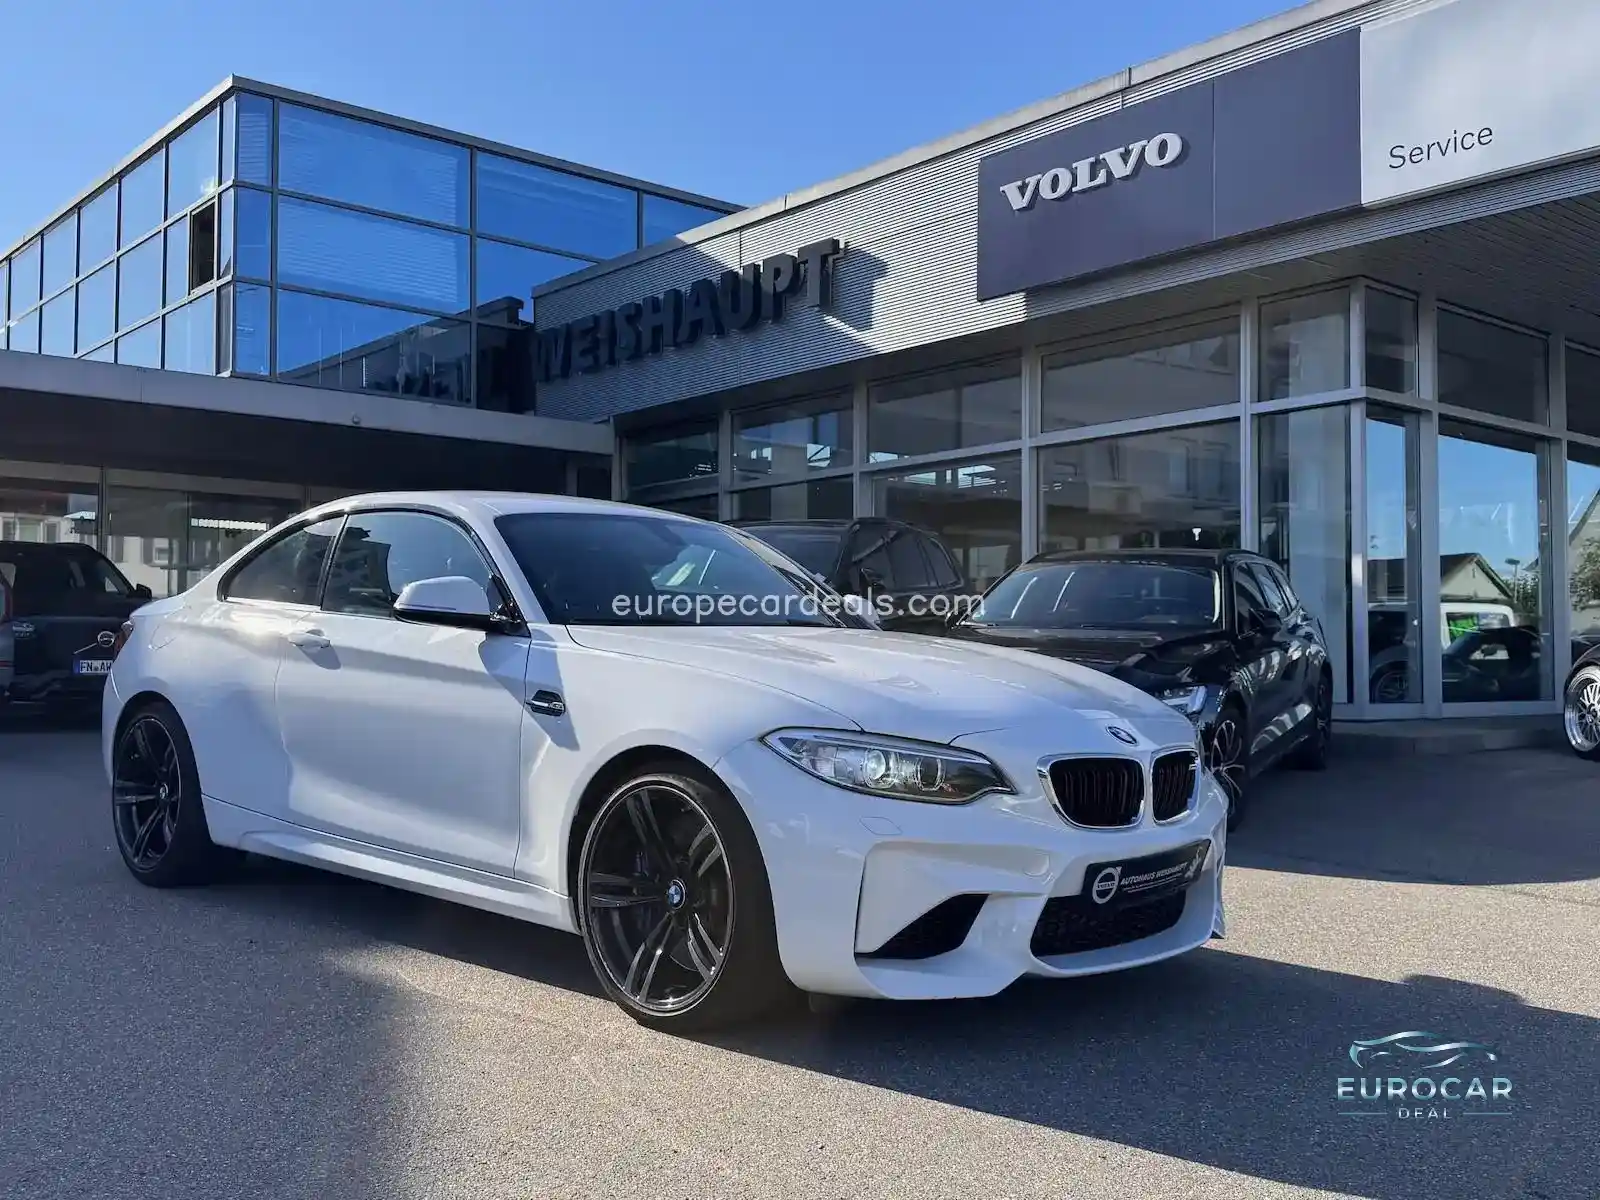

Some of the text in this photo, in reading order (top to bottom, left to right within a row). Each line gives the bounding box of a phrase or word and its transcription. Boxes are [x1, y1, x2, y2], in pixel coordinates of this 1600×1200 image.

[1000, 132, 1183, 212] VOLVO
[1388, 125, 1494, 170] Service
[530, 237, 838, 382] WEISHAUPT
